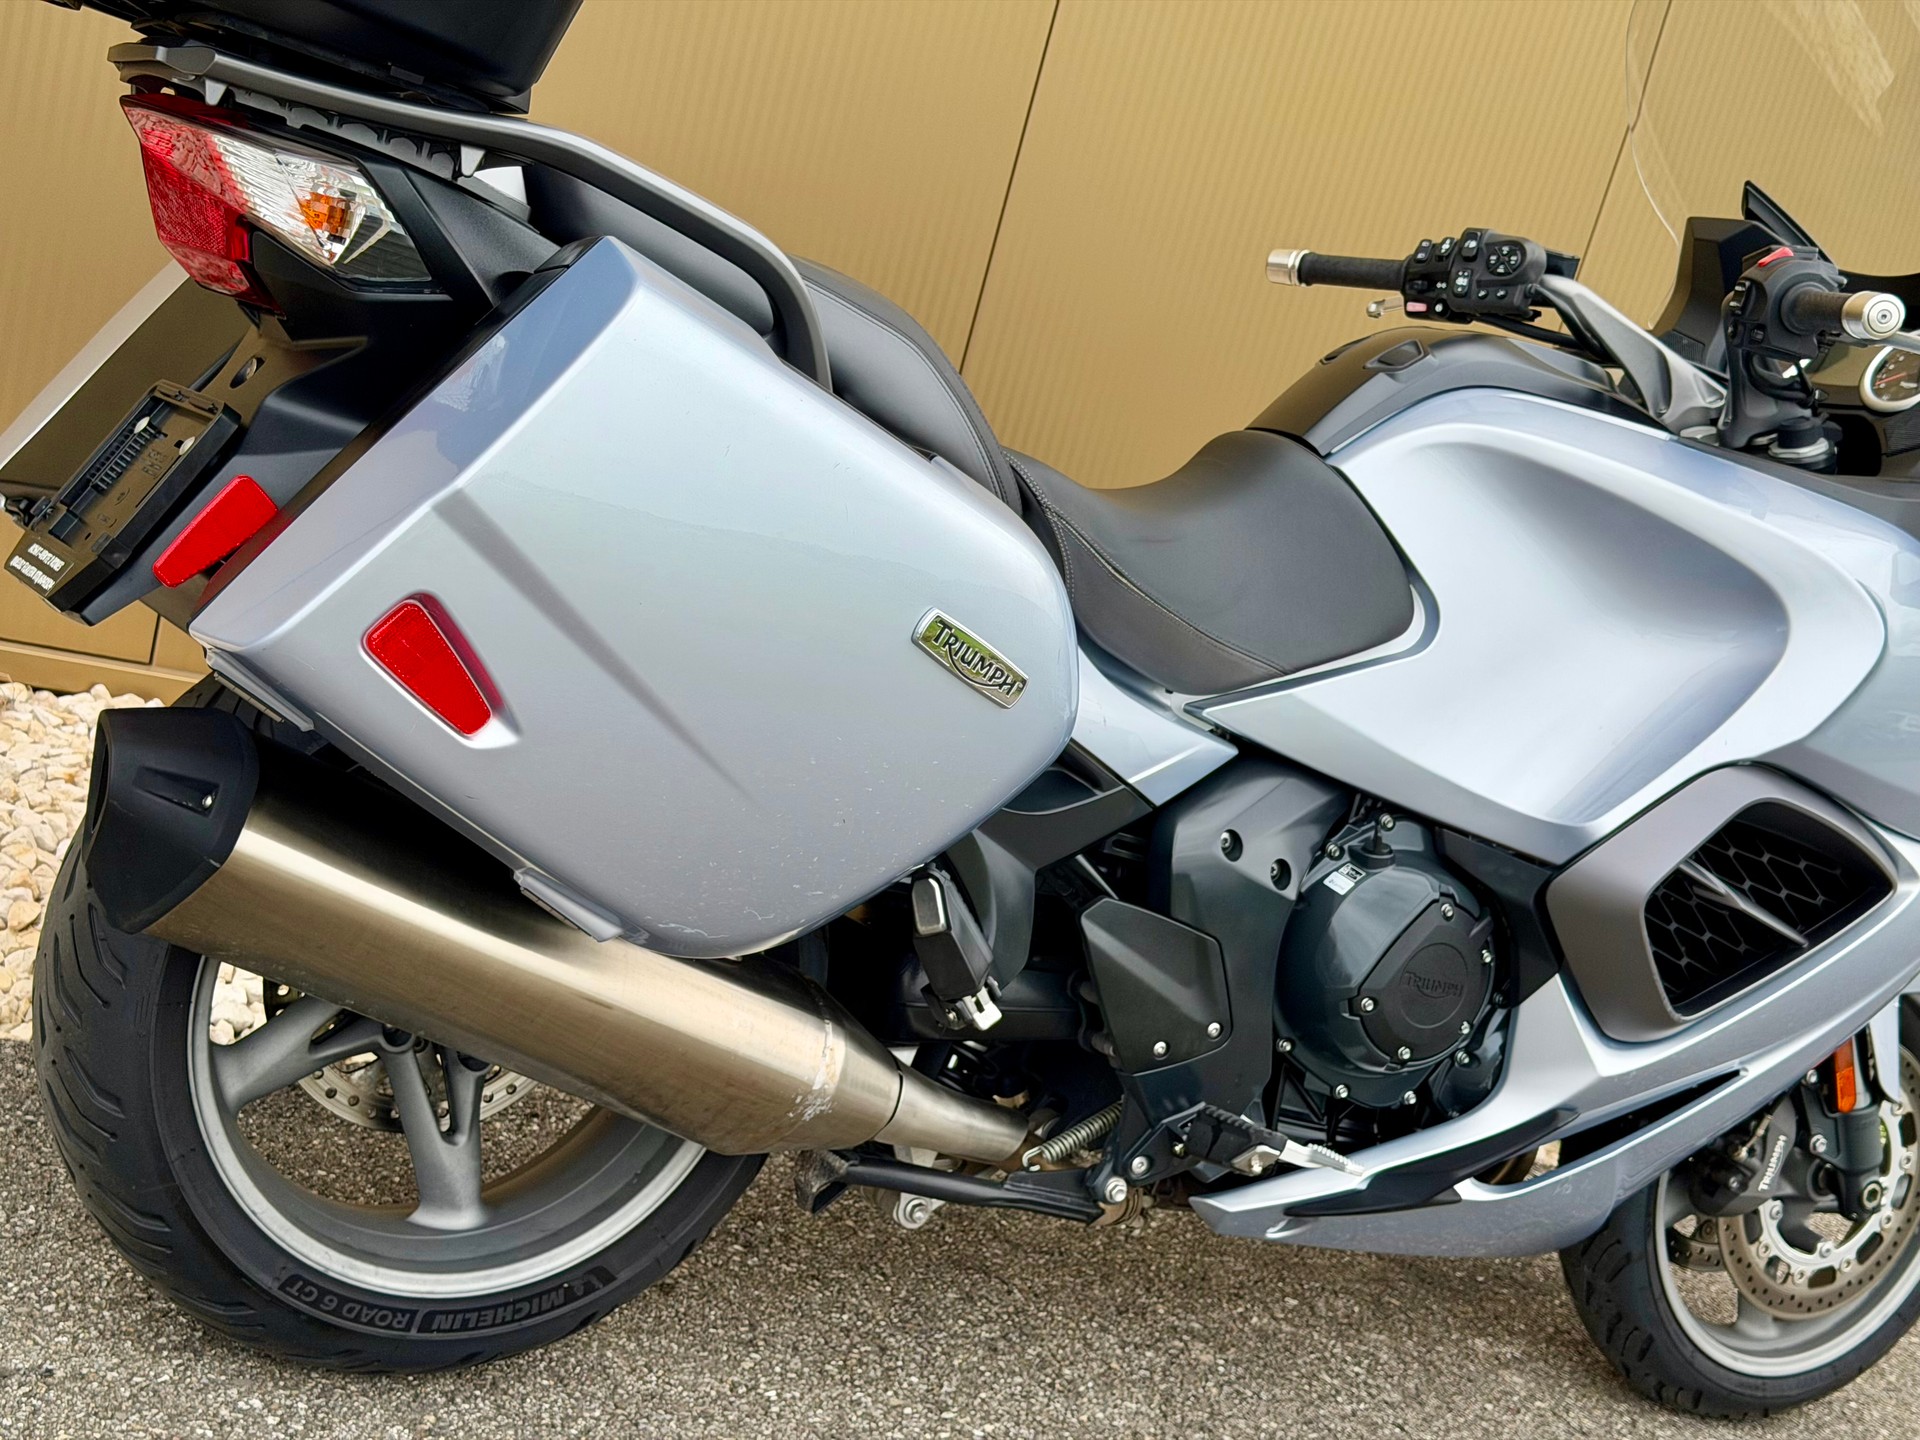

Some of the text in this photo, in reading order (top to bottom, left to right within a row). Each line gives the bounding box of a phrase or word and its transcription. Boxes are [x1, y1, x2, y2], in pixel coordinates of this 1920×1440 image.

[931, 618, 1019, 697] TRIUMPH
[1404, 969, 1465, 999] TRIUMPH
[1757, 1134, 1788, 1192] TRIUMPH
[285, 1280, 566, 1331] MICHELIN ROAD 6 GT
